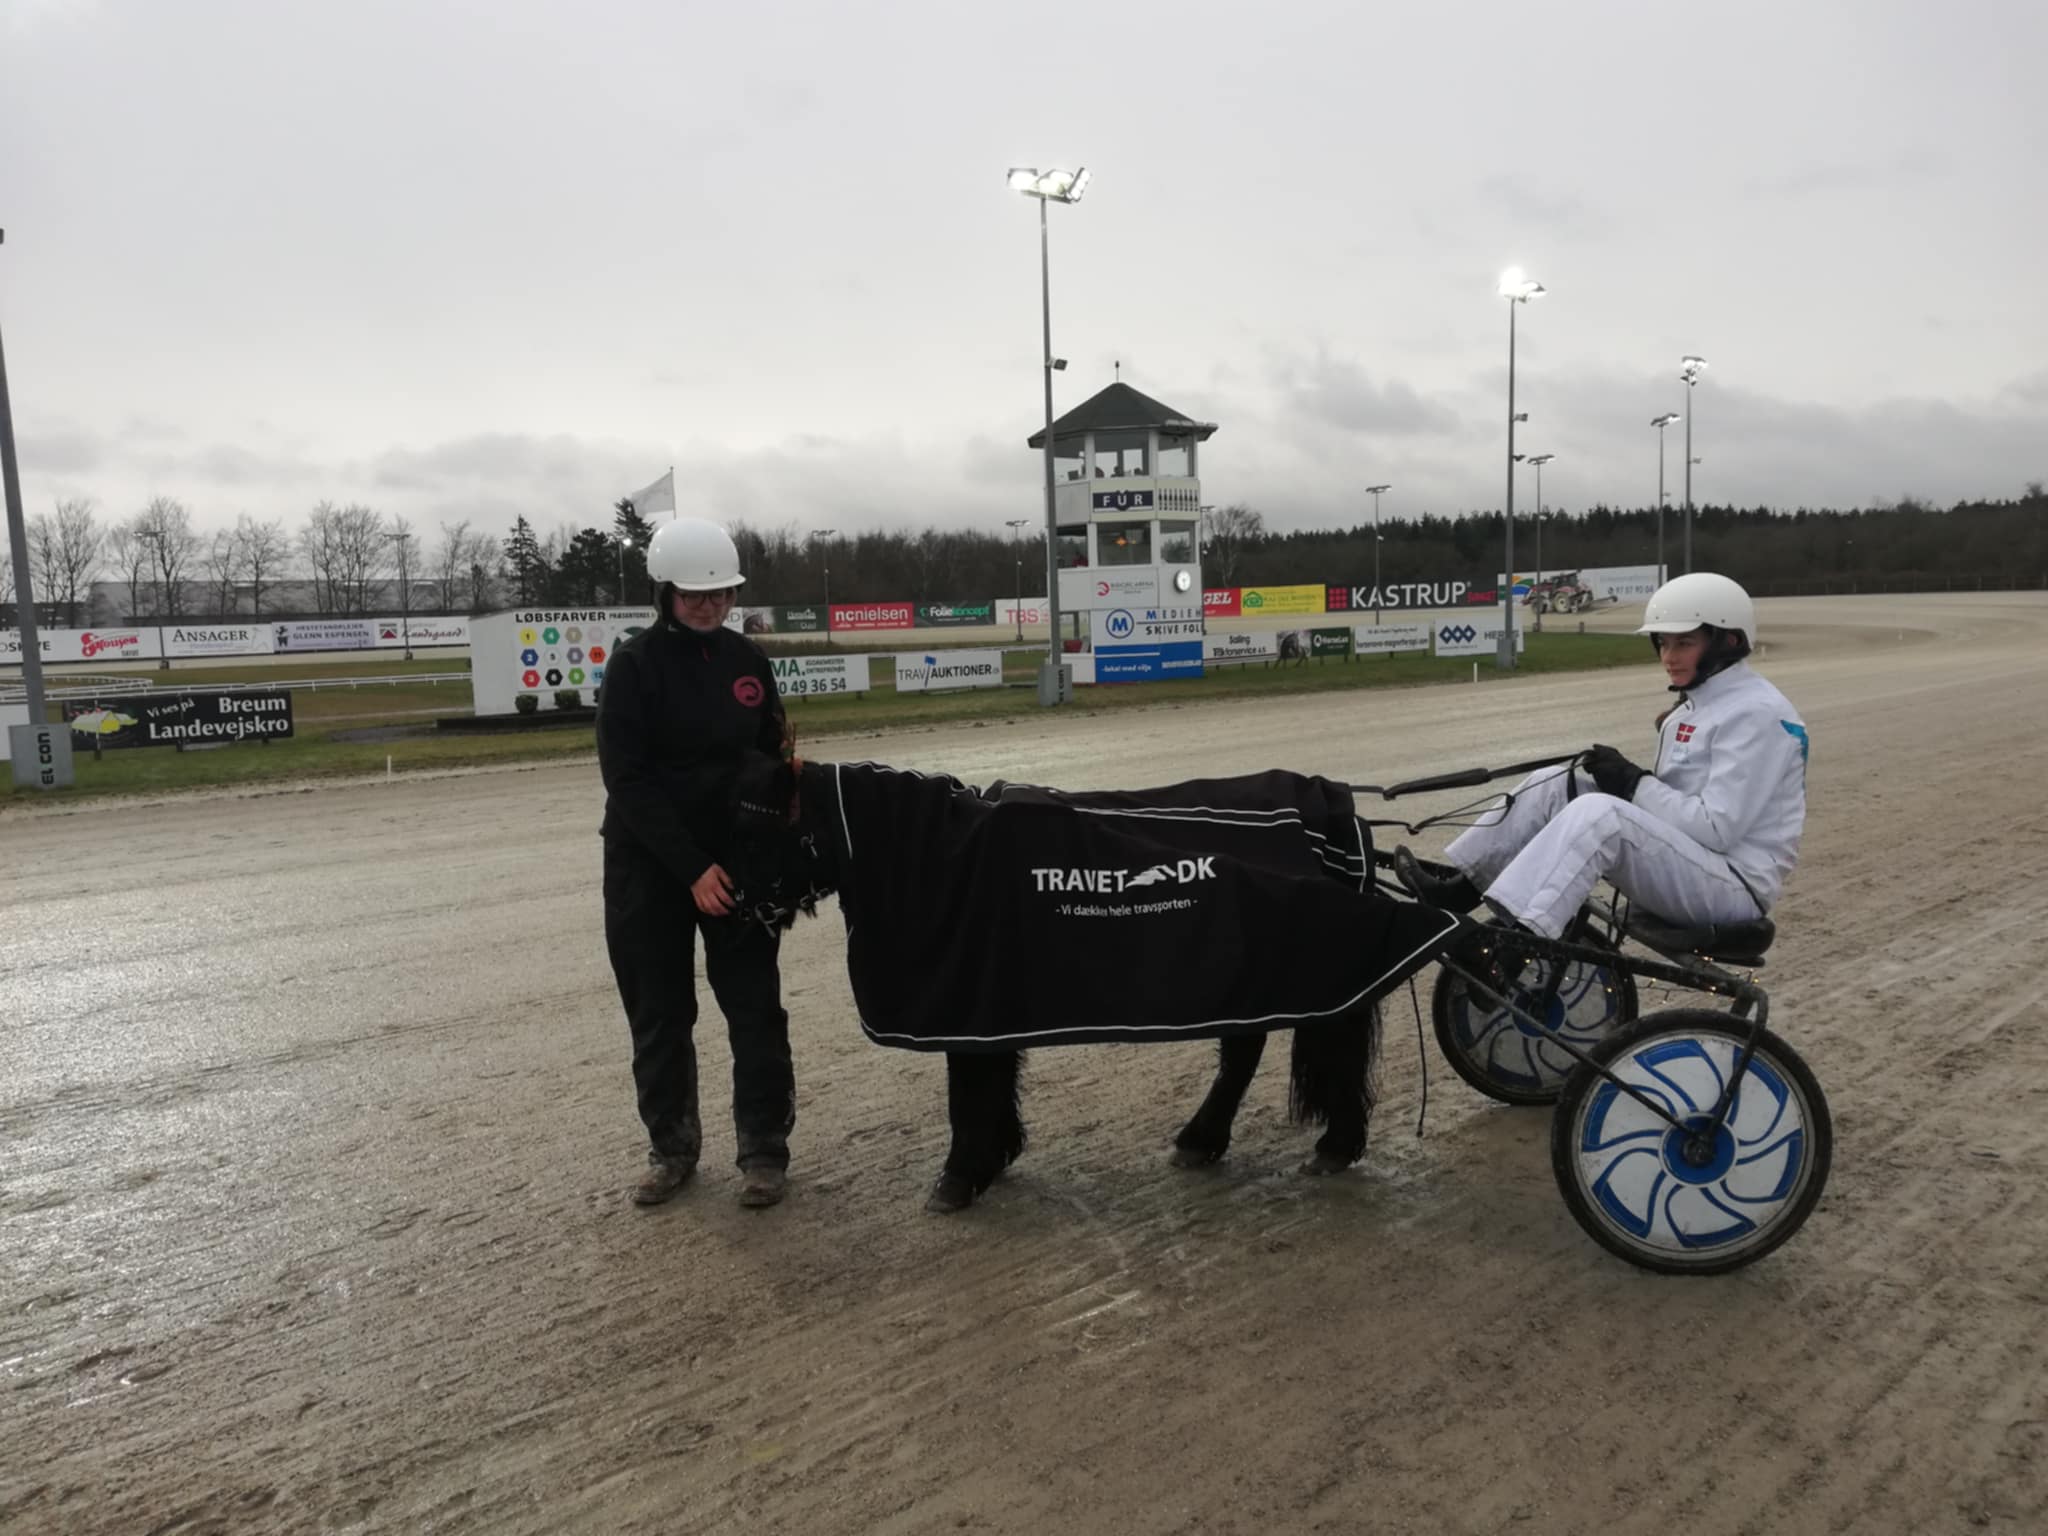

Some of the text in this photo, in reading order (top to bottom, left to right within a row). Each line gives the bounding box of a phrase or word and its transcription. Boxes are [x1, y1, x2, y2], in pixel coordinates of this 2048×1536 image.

[1103, 494, 1143, 506] FUR
[1352, 581, 1466, 608] KASTRUP
[515, 612, 606, 623] LØBSFARVER
[1005, 608, 1039, 624] TBS
[1146, 625, 1179, 635] SKIVE
[898, 668, 925, 680] TRAV
[931, 664, 992, 678] AUKTIONER
[791, 680, 807, 693] 49
[811, 679, 827, 692] 36
[831, 677, 847, 690] 54
[147, 697, 195, 718] Vi ses på
[219, 697, 287, 713] Breum
[149, 715, 289, 740] Landevejskro
[1031, 856, 1216, 893] TRAVET DK
[1061, 904, 1071, 915] Vi
[1109, 904, 1132, 916] hele
